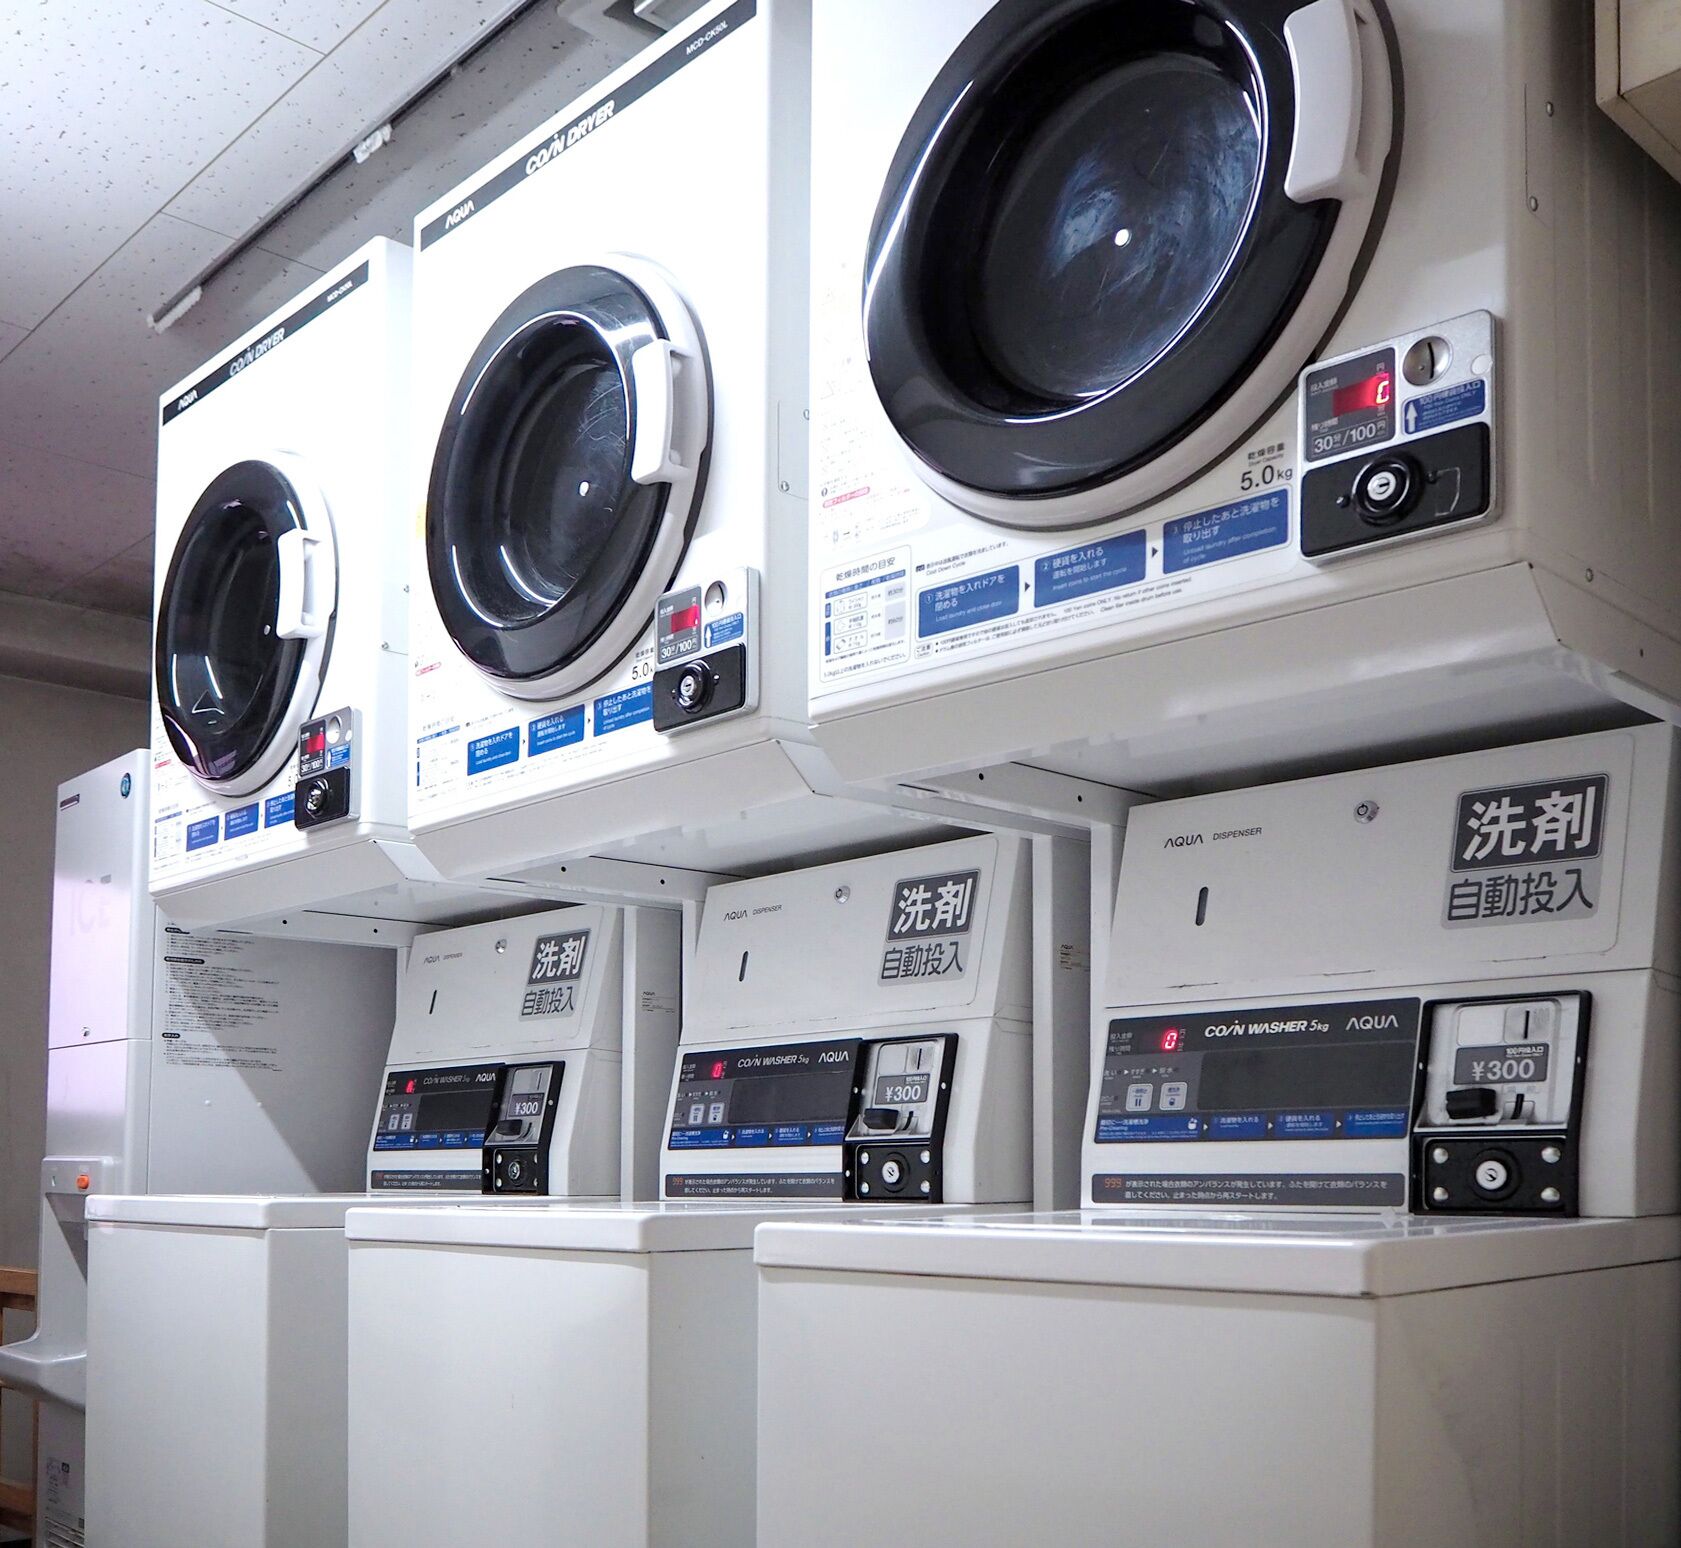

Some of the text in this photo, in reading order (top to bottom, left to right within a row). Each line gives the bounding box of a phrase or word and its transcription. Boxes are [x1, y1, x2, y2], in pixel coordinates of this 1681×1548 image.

[525, 99, 615, 176] COIN DRYER
[445, 200, 475, 229] AQUA
[255, 328, 286, 359] DRYER
[1462, 786, 1597, 862] 洗剤
[1164, 826, 1262, 849] AQUA DISPENSER
[1447, 868, 1594, 922] 自動投入
[723, 904, 783, 922] AQUA DISPENSER
[893, 878, 973, 935] 洗剤
[532, 936, 586, 980] 洗剤
[881, 941, 963, 980] 自動投入
[521, 986, 575, 1016] 自動投入
[1205, 1019, 1330, 1038] COIN WASHER 5kg
[1346, 1015, 1399, 1031] AQUA
[1164, 1032, 1178, 1049] 0
[737, 1054, 761, 1068] COIN
[762, 1055, 797, 1066] WASHER
[818, 1051, 849, 1063] AQUA
[475, 1073, 496, 1082] AQUA
[1471, 1059, 1535, 1081] ¥300
[885, 1085, 921, 1102] ¥300
[515, 1101, 539, 1115] ¥300
